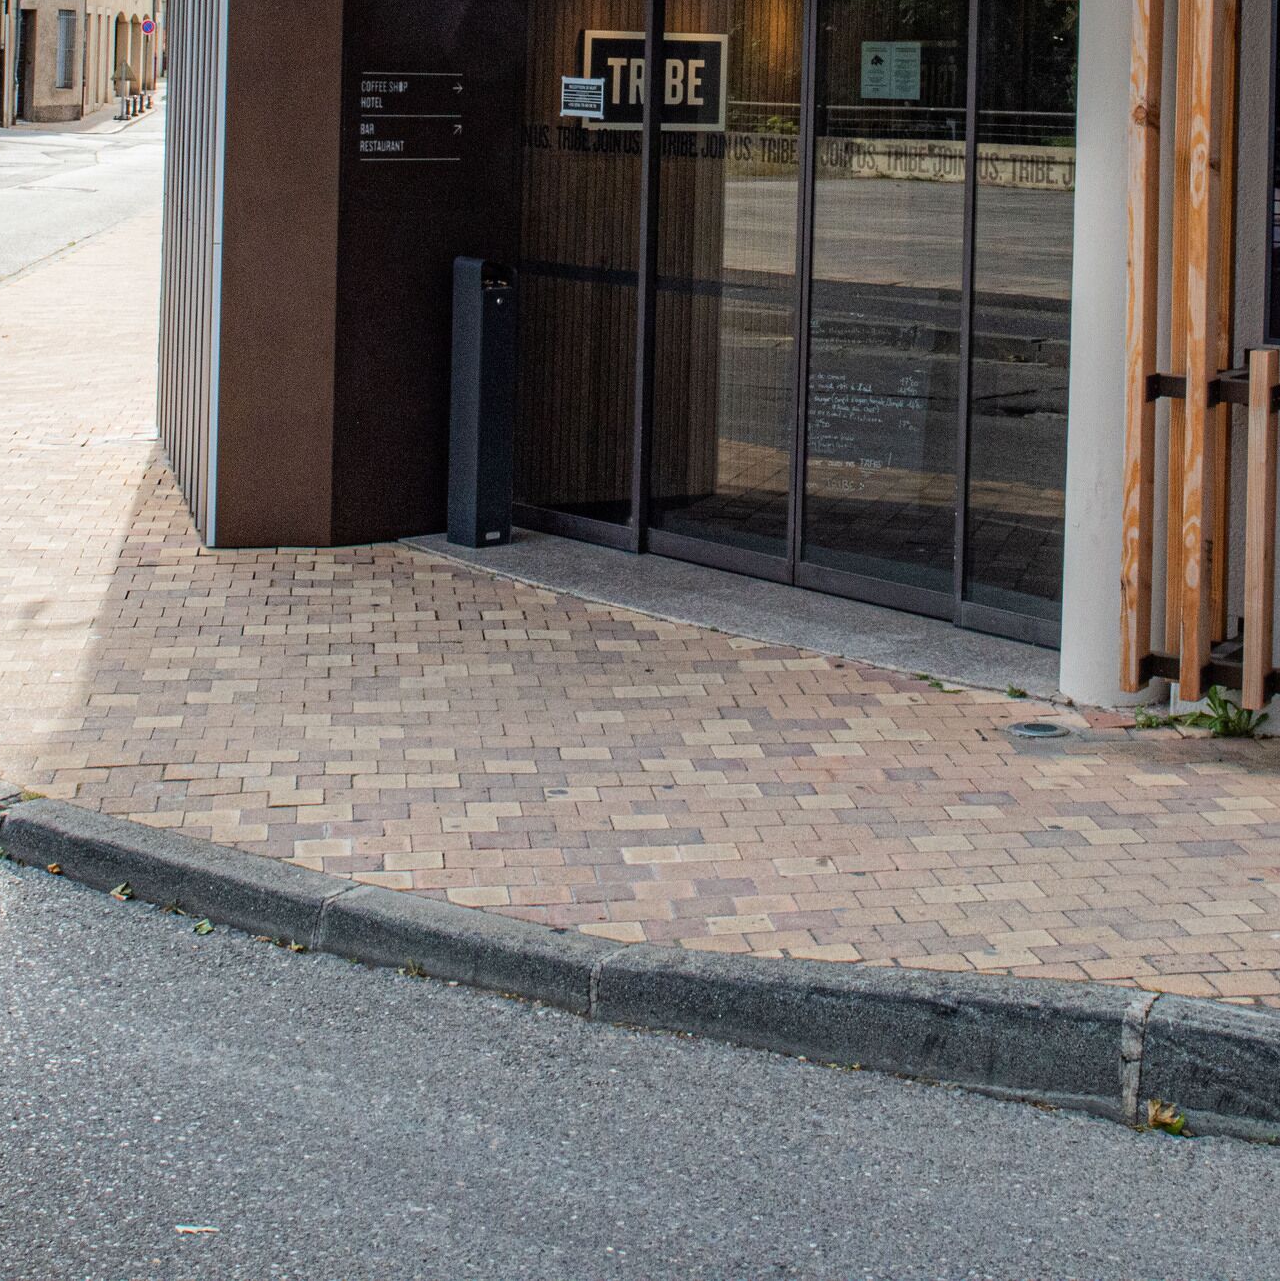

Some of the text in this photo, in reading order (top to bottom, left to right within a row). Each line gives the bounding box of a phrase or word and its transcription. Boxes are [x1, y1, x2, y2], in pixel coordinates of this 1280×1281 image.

[361, 81, 408, 93] COFFEE SHOP
[607, 58, 705, 106] TRBE
[360, 96, 383, 109] HOTEL
[360, 123, 375, 135] BAR
[360, 140, 404, 152] RESTAURANT
[1009, 153, 1058, 185] TRIBE.
